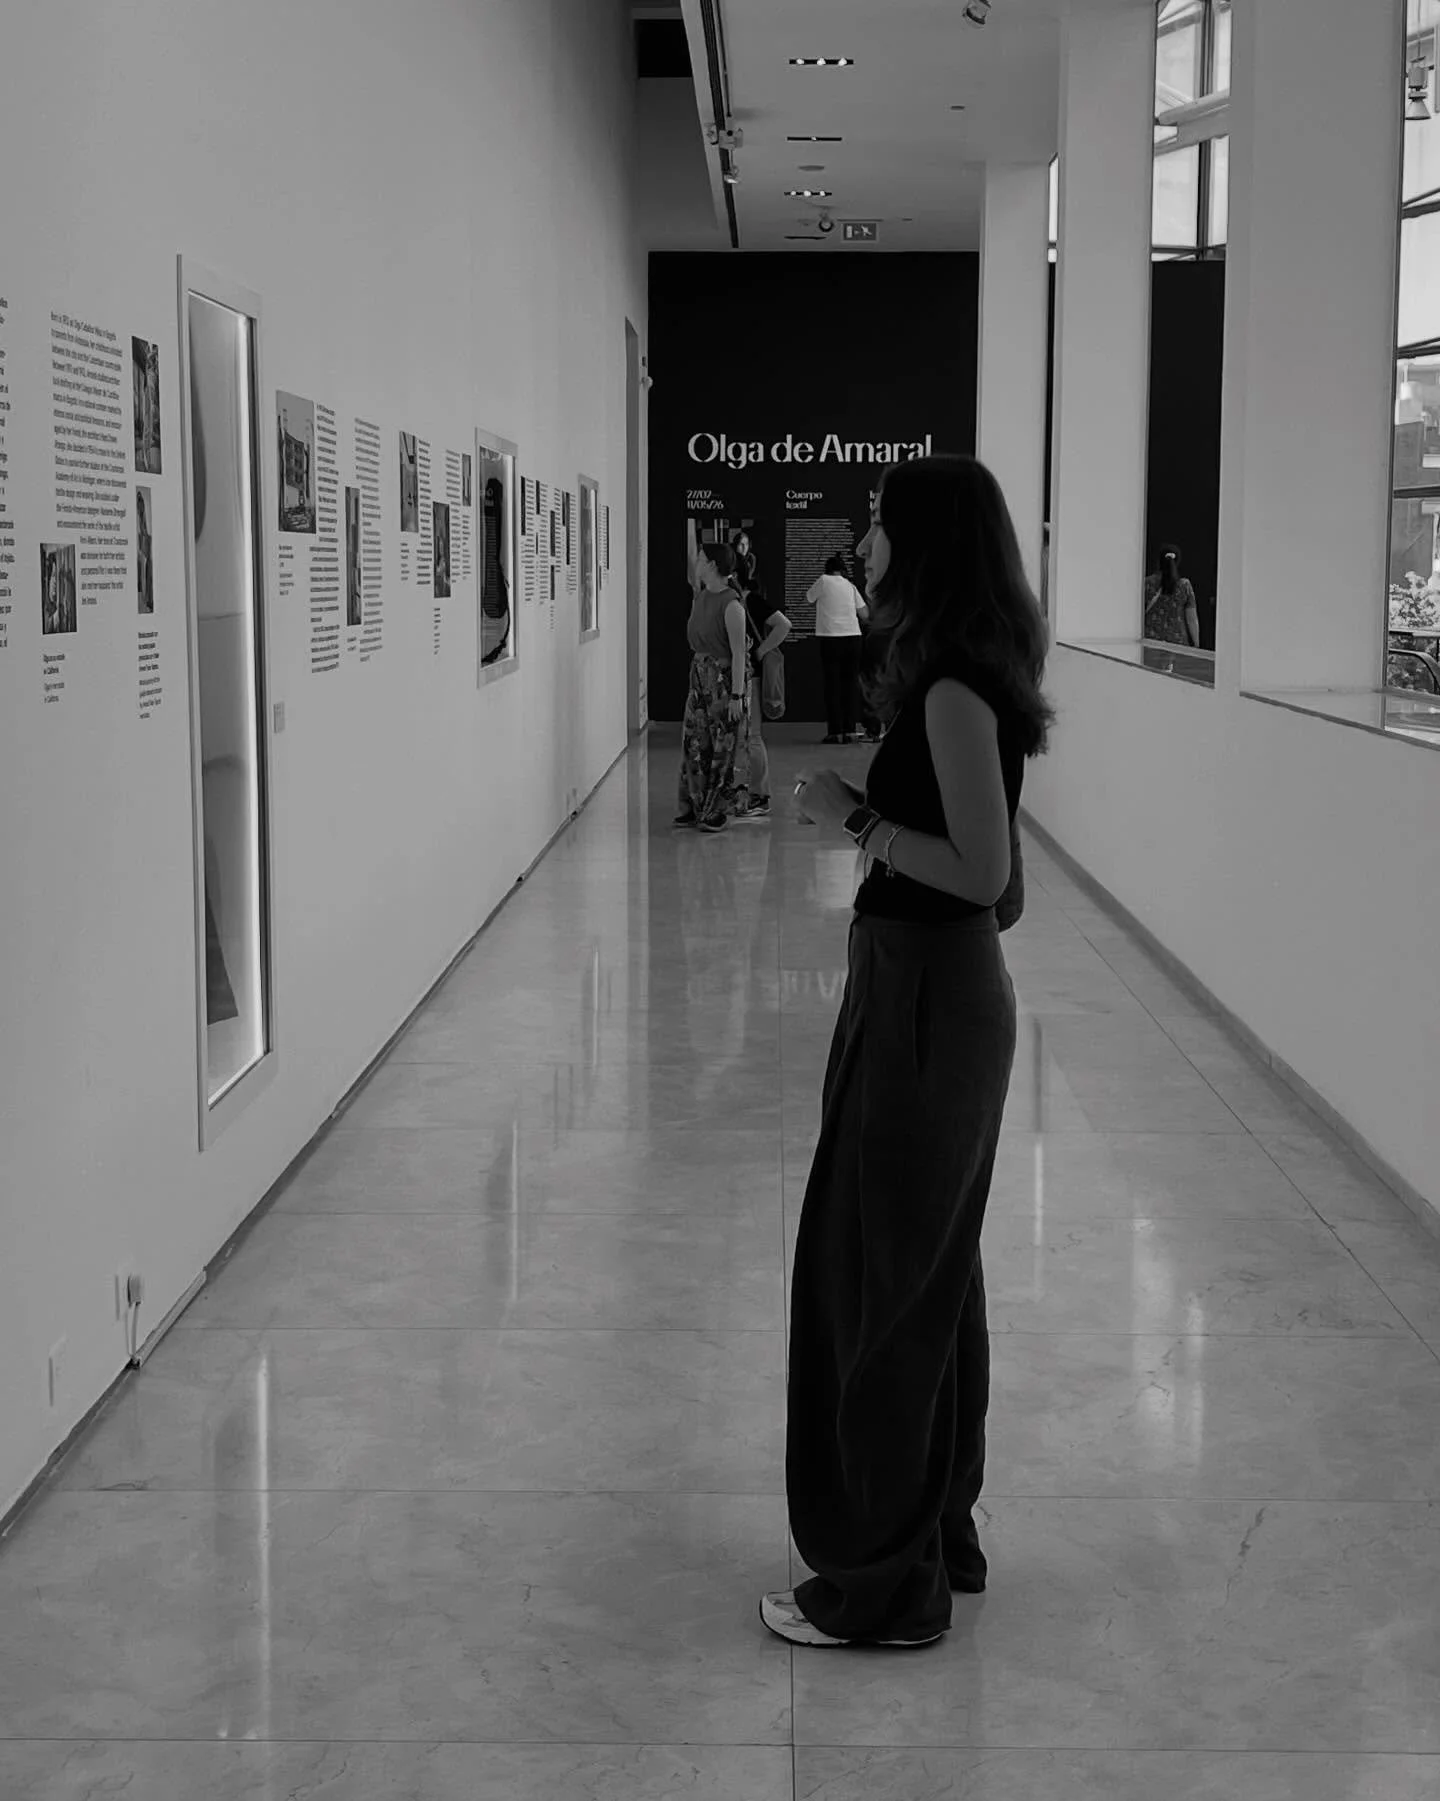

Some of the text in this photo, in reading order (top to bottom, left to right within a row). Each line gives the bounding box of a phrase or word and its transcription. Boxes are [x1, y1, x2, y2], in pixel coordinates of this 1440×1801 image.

[687, 432, 932, 470] Olga de Amaral
[785, 489, 823, 501] Cuerpo
[785, 500, 808, 510] textil
